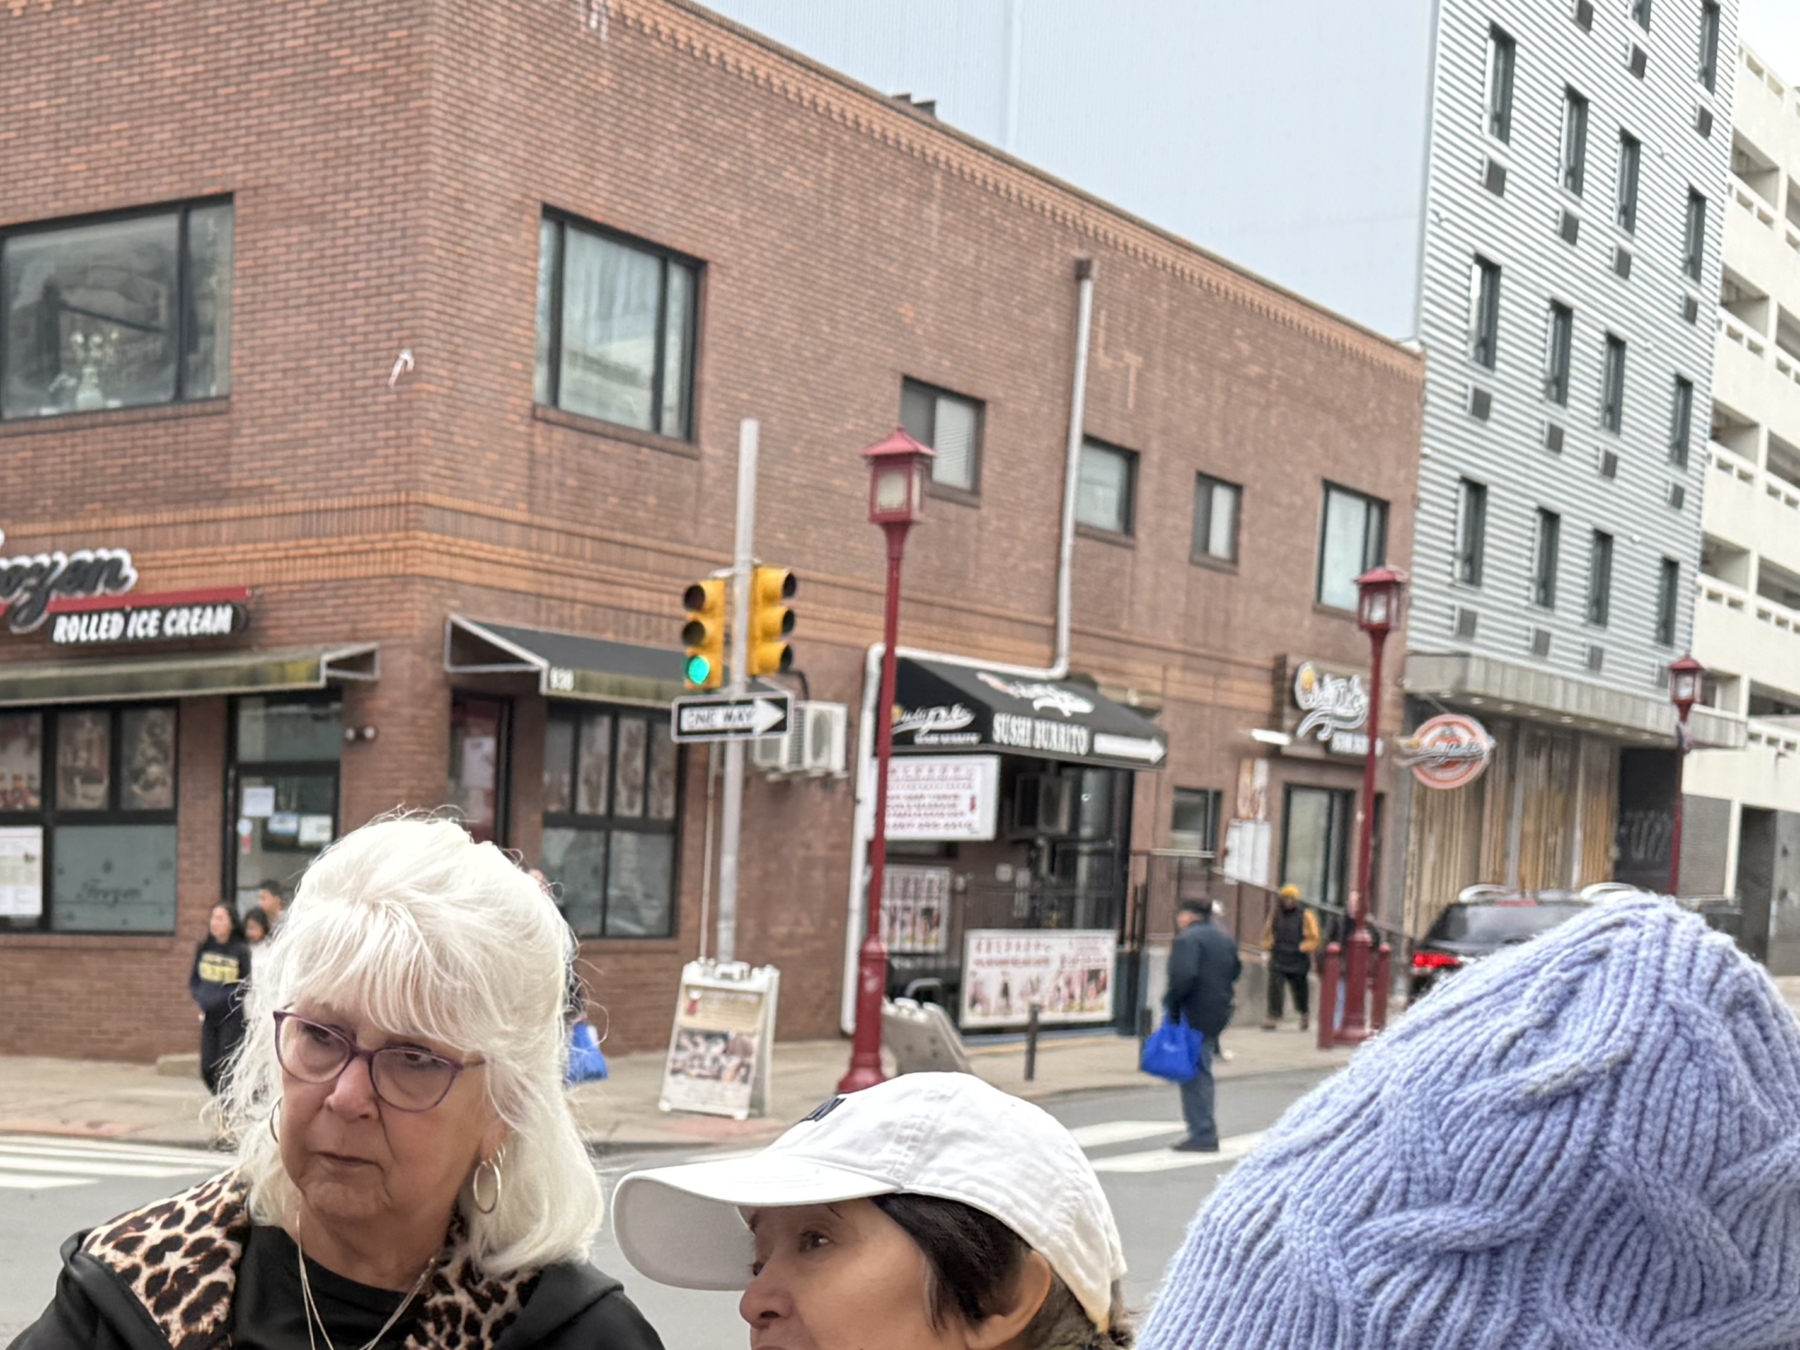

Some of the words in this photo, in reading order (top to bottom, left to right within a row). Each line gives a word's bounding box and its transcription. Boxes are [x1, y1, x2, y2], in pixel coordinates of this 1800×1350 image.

[53, 610, 125, 644] ROLLED
[126, 606, 161, 638] ICE
[162, 603, 234, 636] CREAM
[685, 706, 718, 728] ONE
[721, 706, 754, 725] WAY
[992, 713, 1032, 748] SUSHI
[1033, 718, 1090, 755] BURRITO
